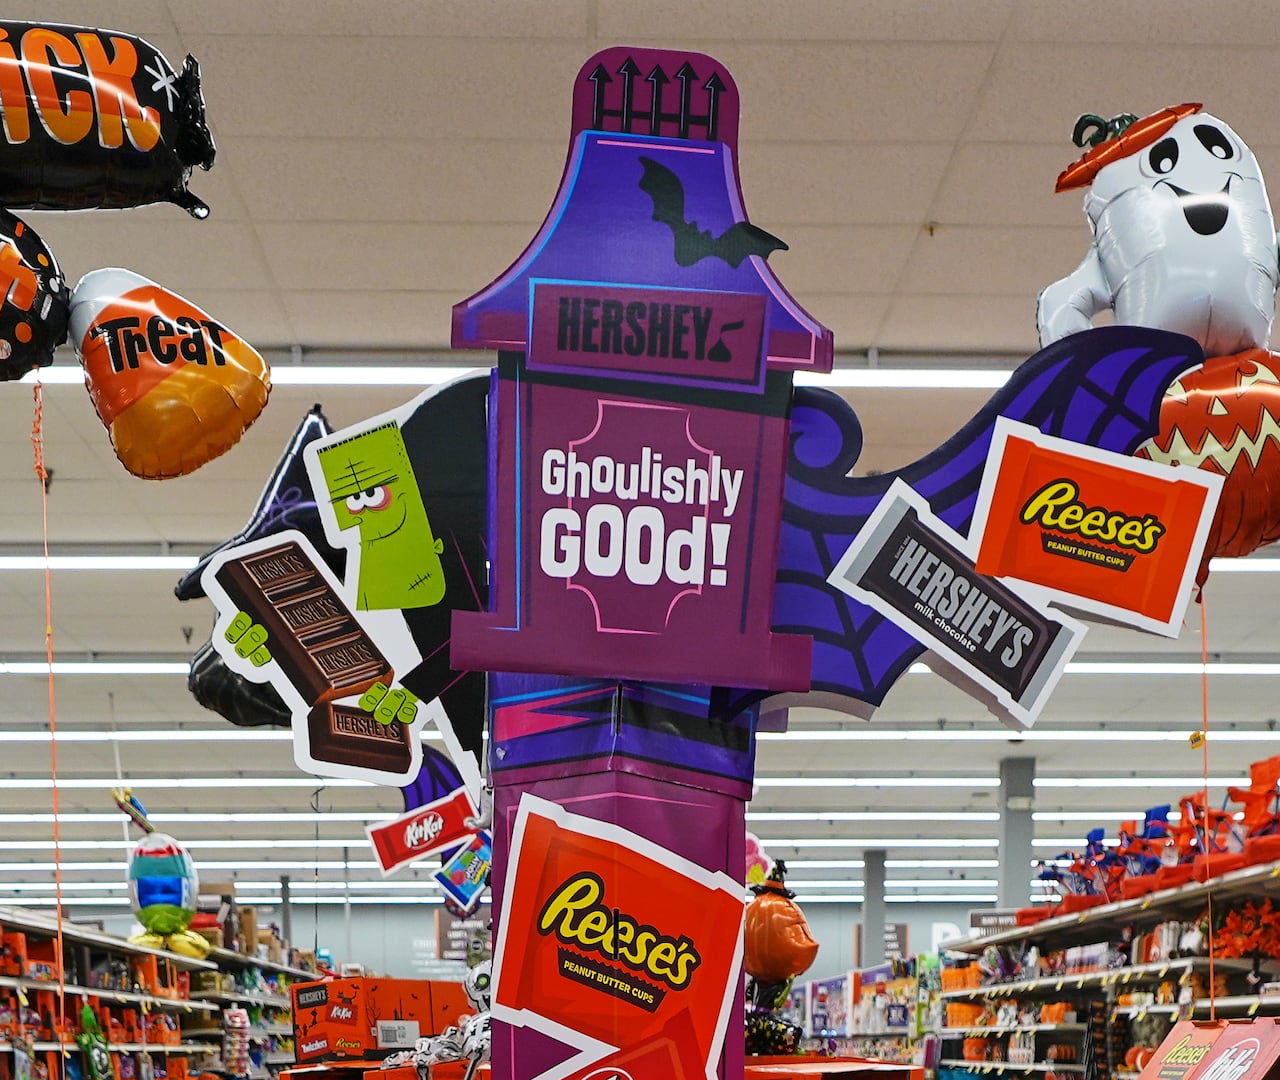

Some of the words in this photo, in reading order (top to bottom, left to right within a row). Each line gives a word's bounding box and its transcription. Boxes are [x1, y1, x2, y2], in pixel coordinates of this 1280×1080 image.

[541, 447, 744, 517] Ghoulishly
[1023, 481, 1164, 551] Reese's
[249, 554, 304, 582] HERSHEY'S
[1047, 540, 1076, 554] PEANUT
[1077, 546, 1105, 562] BUTTER
[1106, 554, 1125, 567] CUPS
[283, 597, 339, 628] HERSHEY'S
[890, 539, 1034, 669] HERSHEY'S
[914, 601, 934, 621] milk
[934, 616, 977, 653] chocolate
[318, 642, 373, 672] HERSHEY'S
[540, 875, 699, 987] Reese's
[563, 959, 597, 981] PEANUT
[596, 971, 631, 996] BUTTER
[631, 986, 654, 1005] CUPS
[336, 1038, 361, 1049] Reese's
